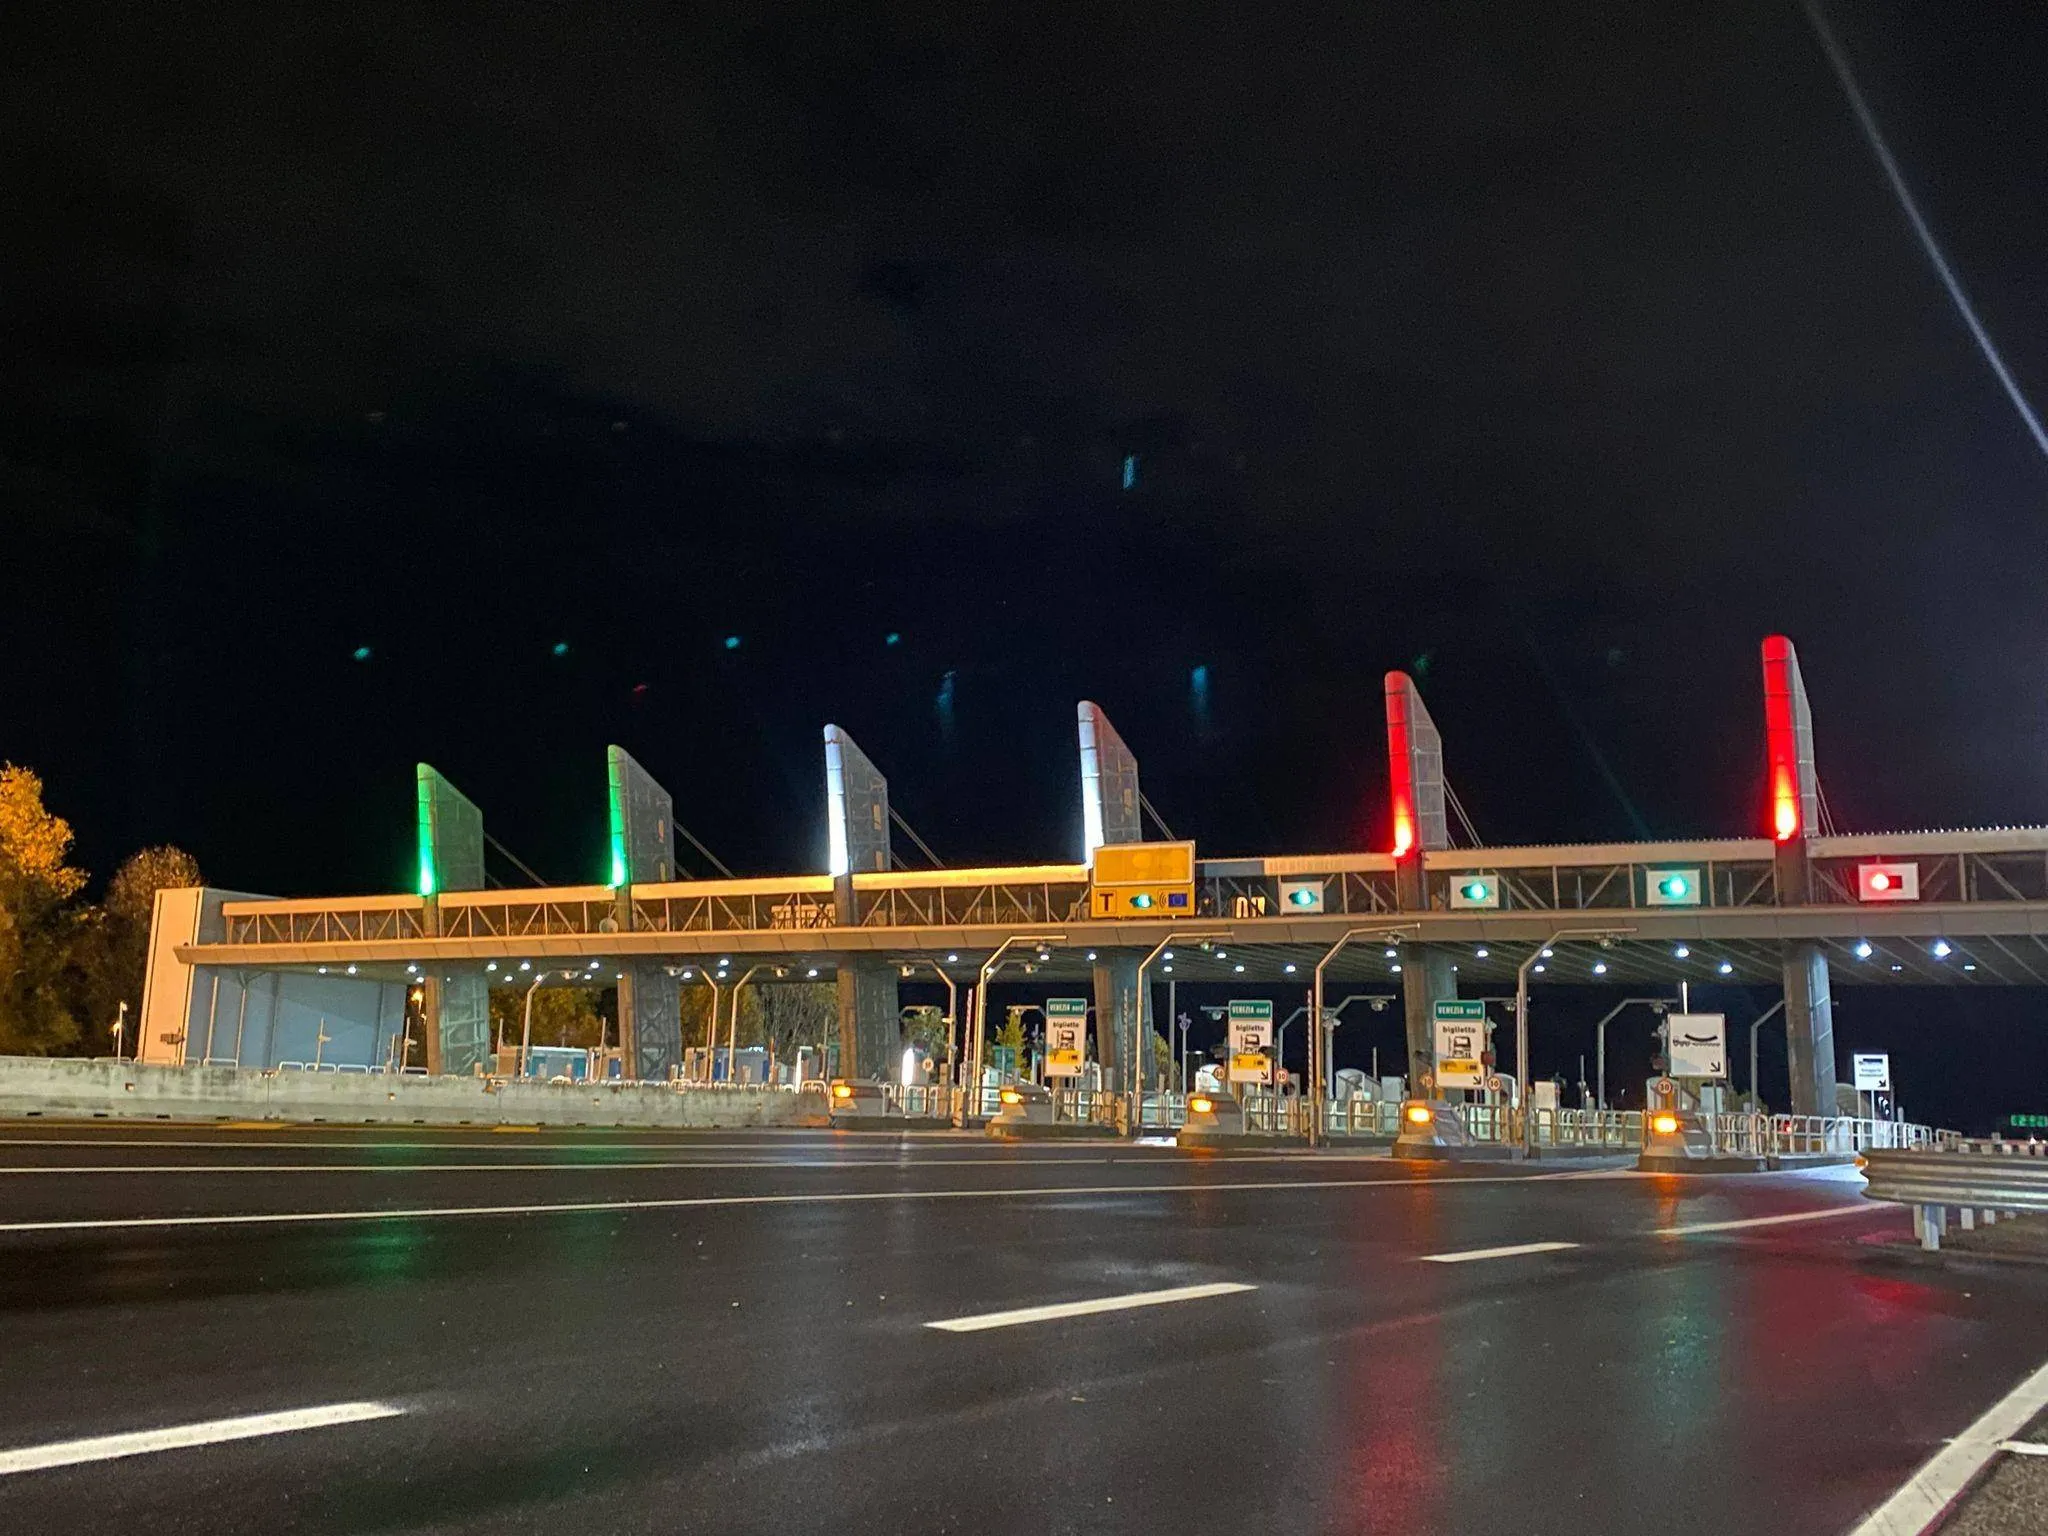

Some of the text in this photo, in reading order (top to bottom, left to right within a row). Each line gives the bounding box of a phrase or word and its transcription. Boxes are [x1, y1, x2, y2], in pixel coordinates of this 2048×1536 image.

[1099, 893, 1114, 912] T
[1049, 1003, 1070, 1012] VENEZIA
[1232, 1005, 1254, 1014] VENEZIA
[1437, 1006, 1481, 1015] VENEZIA nord
[1053, 1021, 1079, 1029] biglietto
[1235, 1024, 1265, 1032] biglietto
[1442, 1025, 1477, 1034] biglietto
